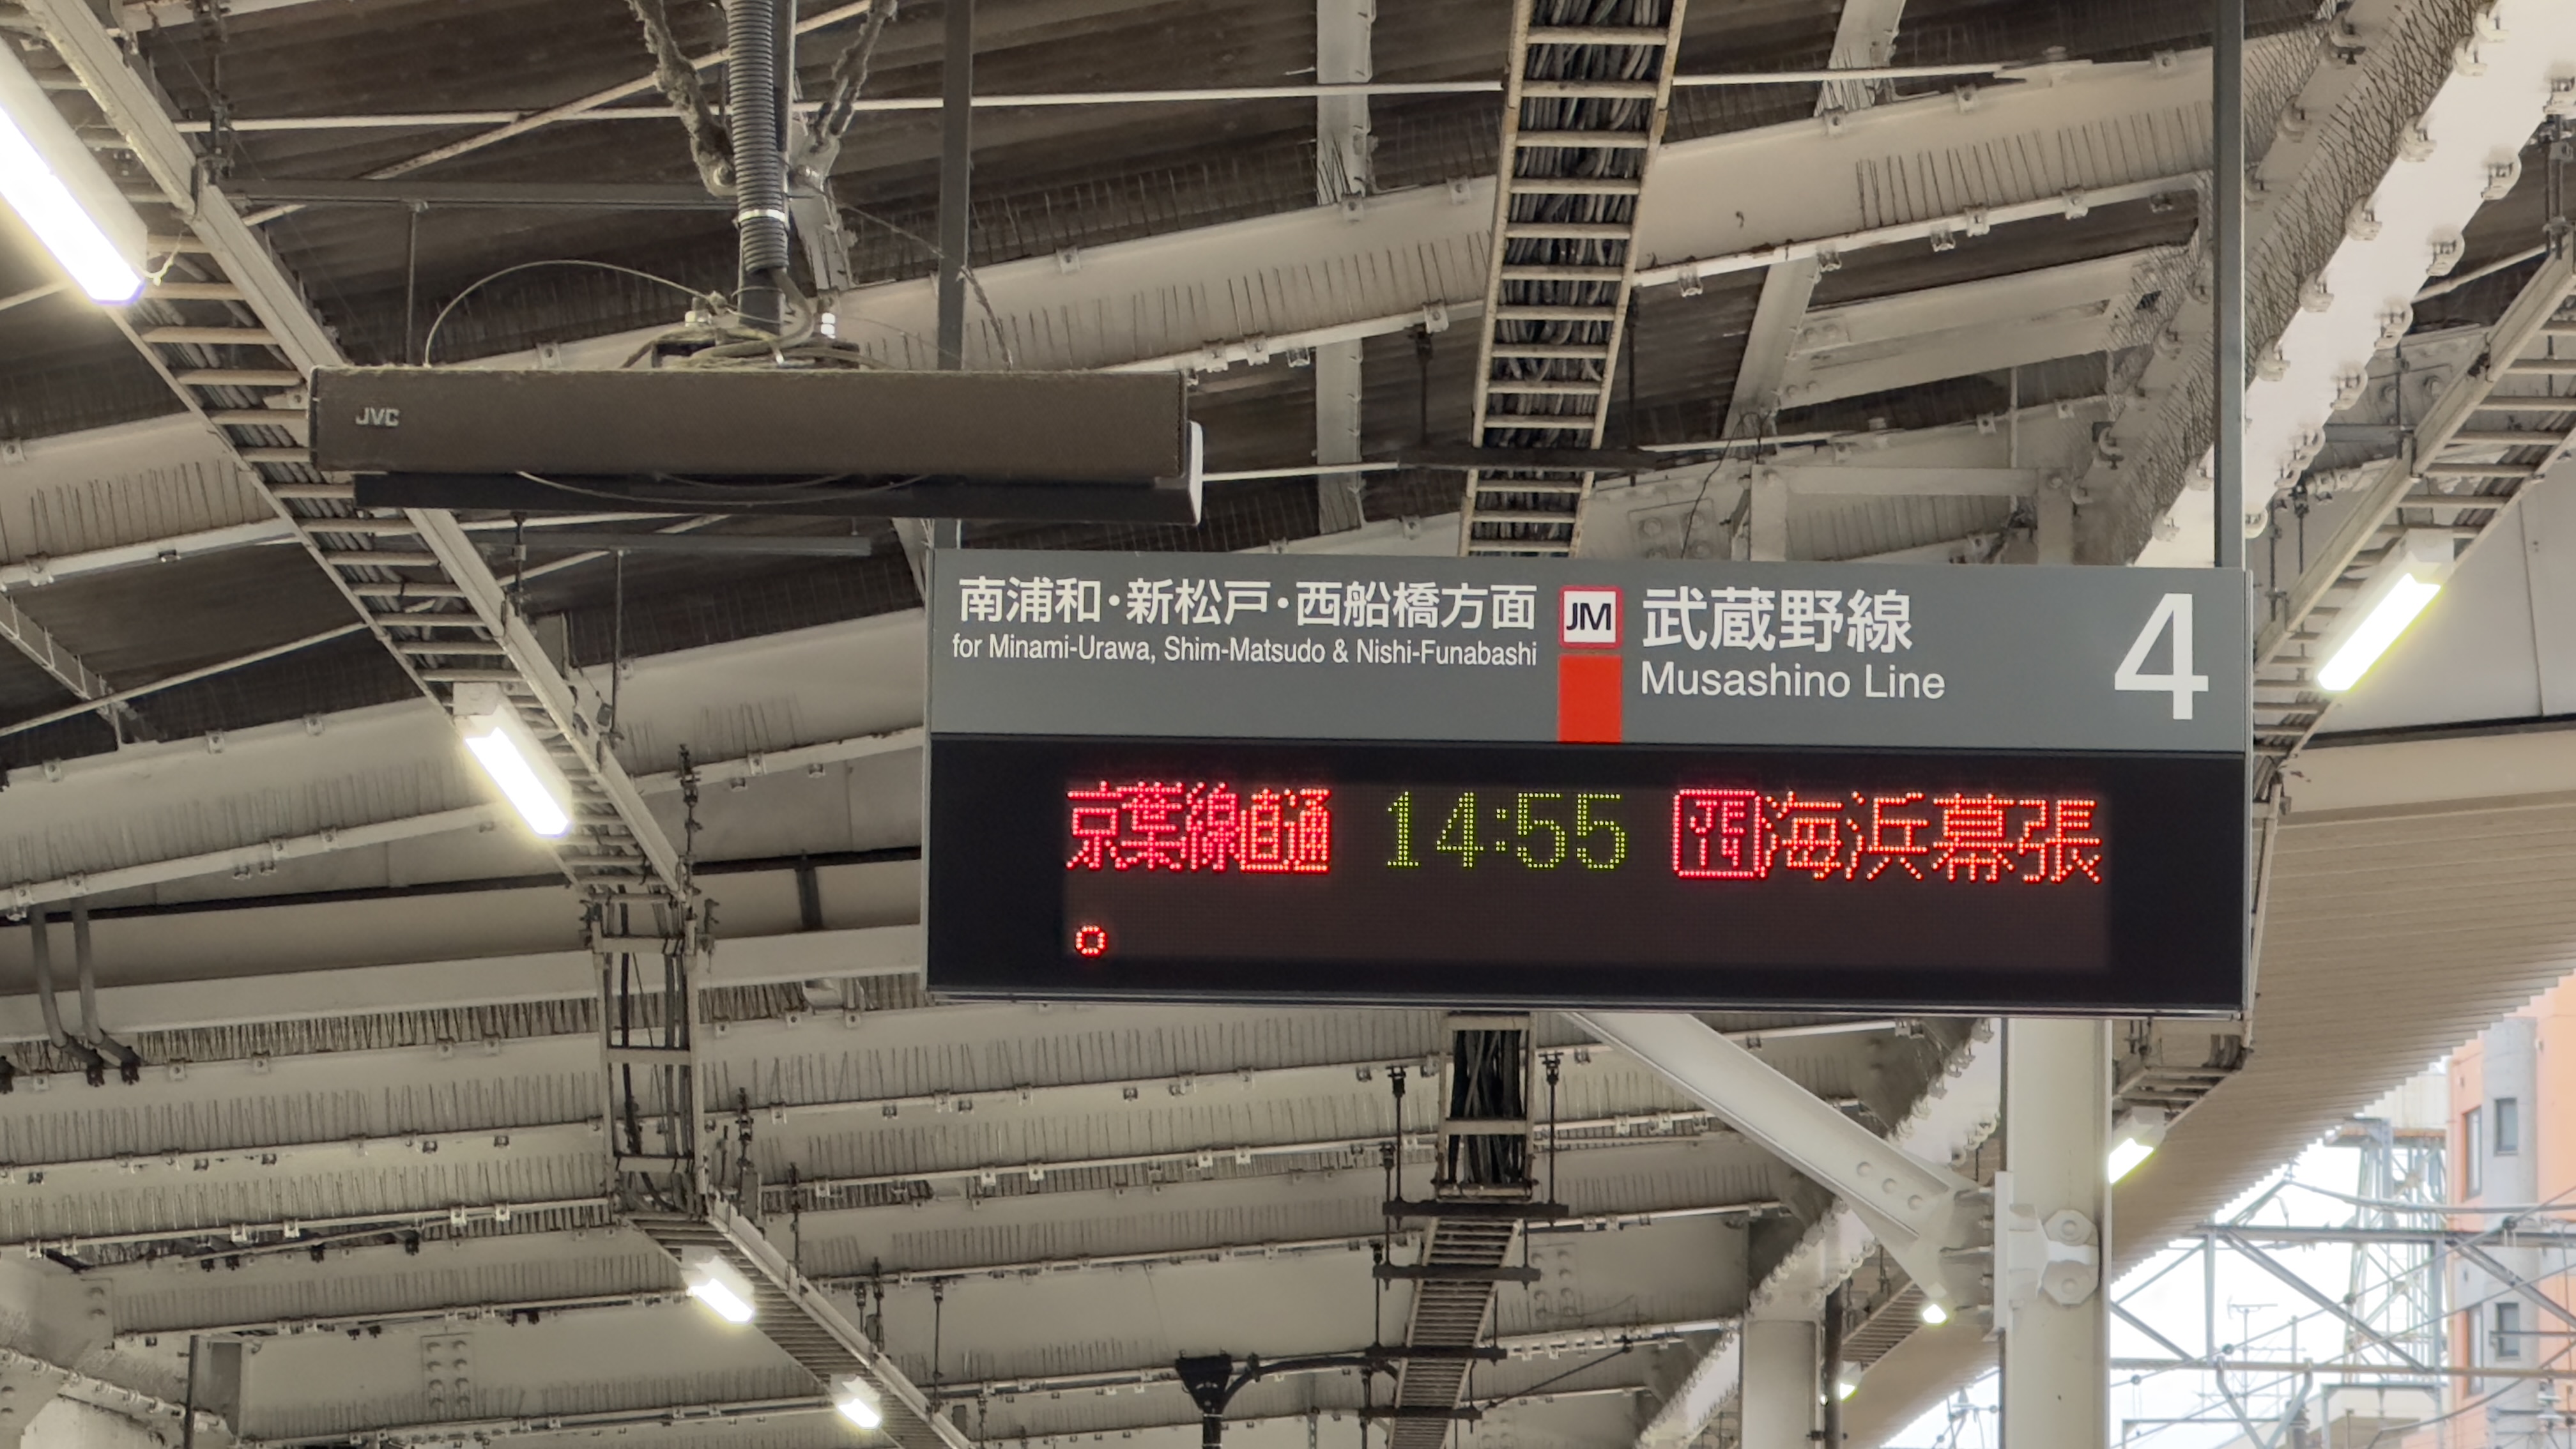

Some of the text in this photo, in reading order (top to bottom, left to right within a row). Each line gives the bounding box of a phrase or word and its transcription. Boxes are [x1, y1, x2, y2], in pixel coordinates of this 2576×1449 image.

[355, 407, 399, 427] JVC
[958, 575, 1538, 631] 南浦和・新松戸・西船橋方面
[1563, 601, 1612, 631] JM
[1642, 585, 1913, 654] 武蔵野線
[952, 632, 1537, 666] for Minami-Urawa, Shim-Matsudo & Nishi-Funabashi
[2113, 592, 2210, 721] 4
[1641, 660, 1946, 700] Musashino Line
[1066, 780, 1331, 873] 京葉線直通
[1386, 790, 1626, 870] 14:55
[1689, 800, 1747, 834] JE
[1759, 790, 2103, 884] 海浜幕張
